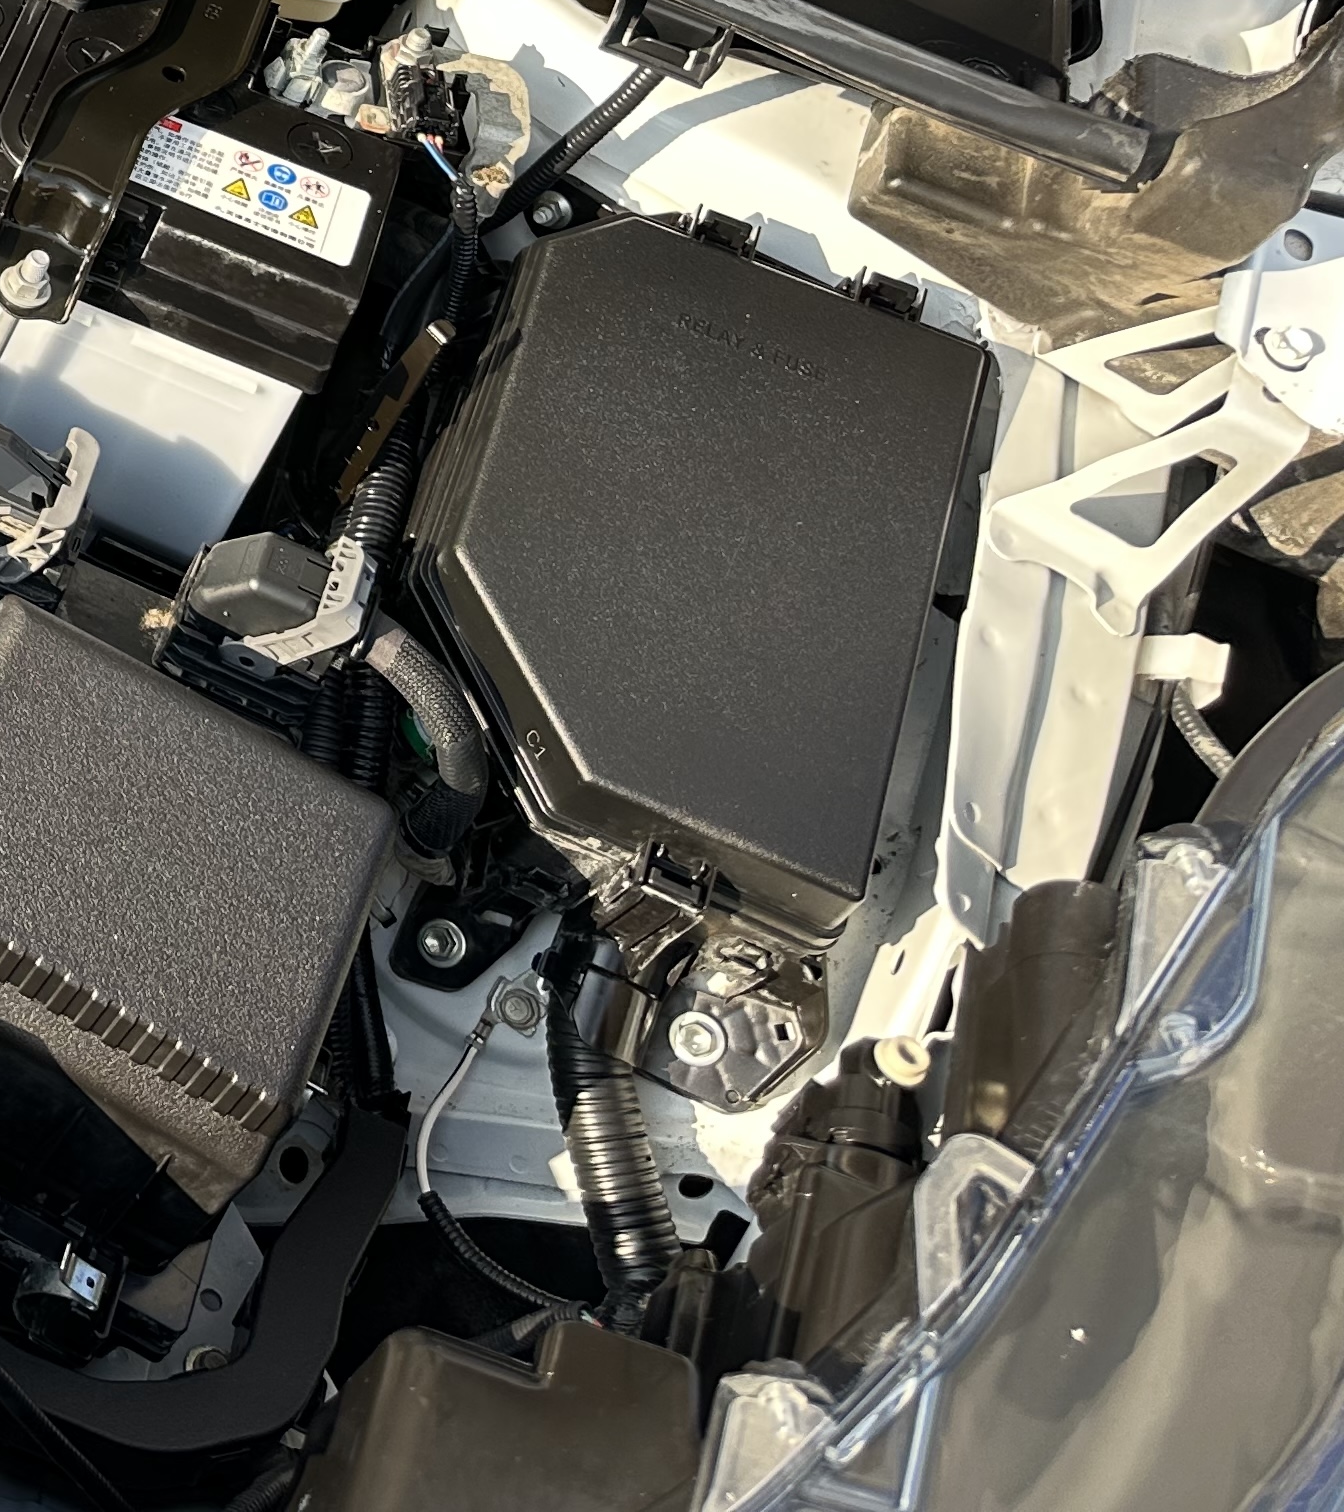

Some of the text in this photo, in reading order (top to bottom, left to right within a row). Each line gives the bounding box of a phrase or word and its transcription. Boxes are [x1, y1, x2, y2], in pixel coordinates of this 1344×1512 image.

[678, 312, 829, 383] RELAY & FUSE
[526, 729, 546, 761] C1
